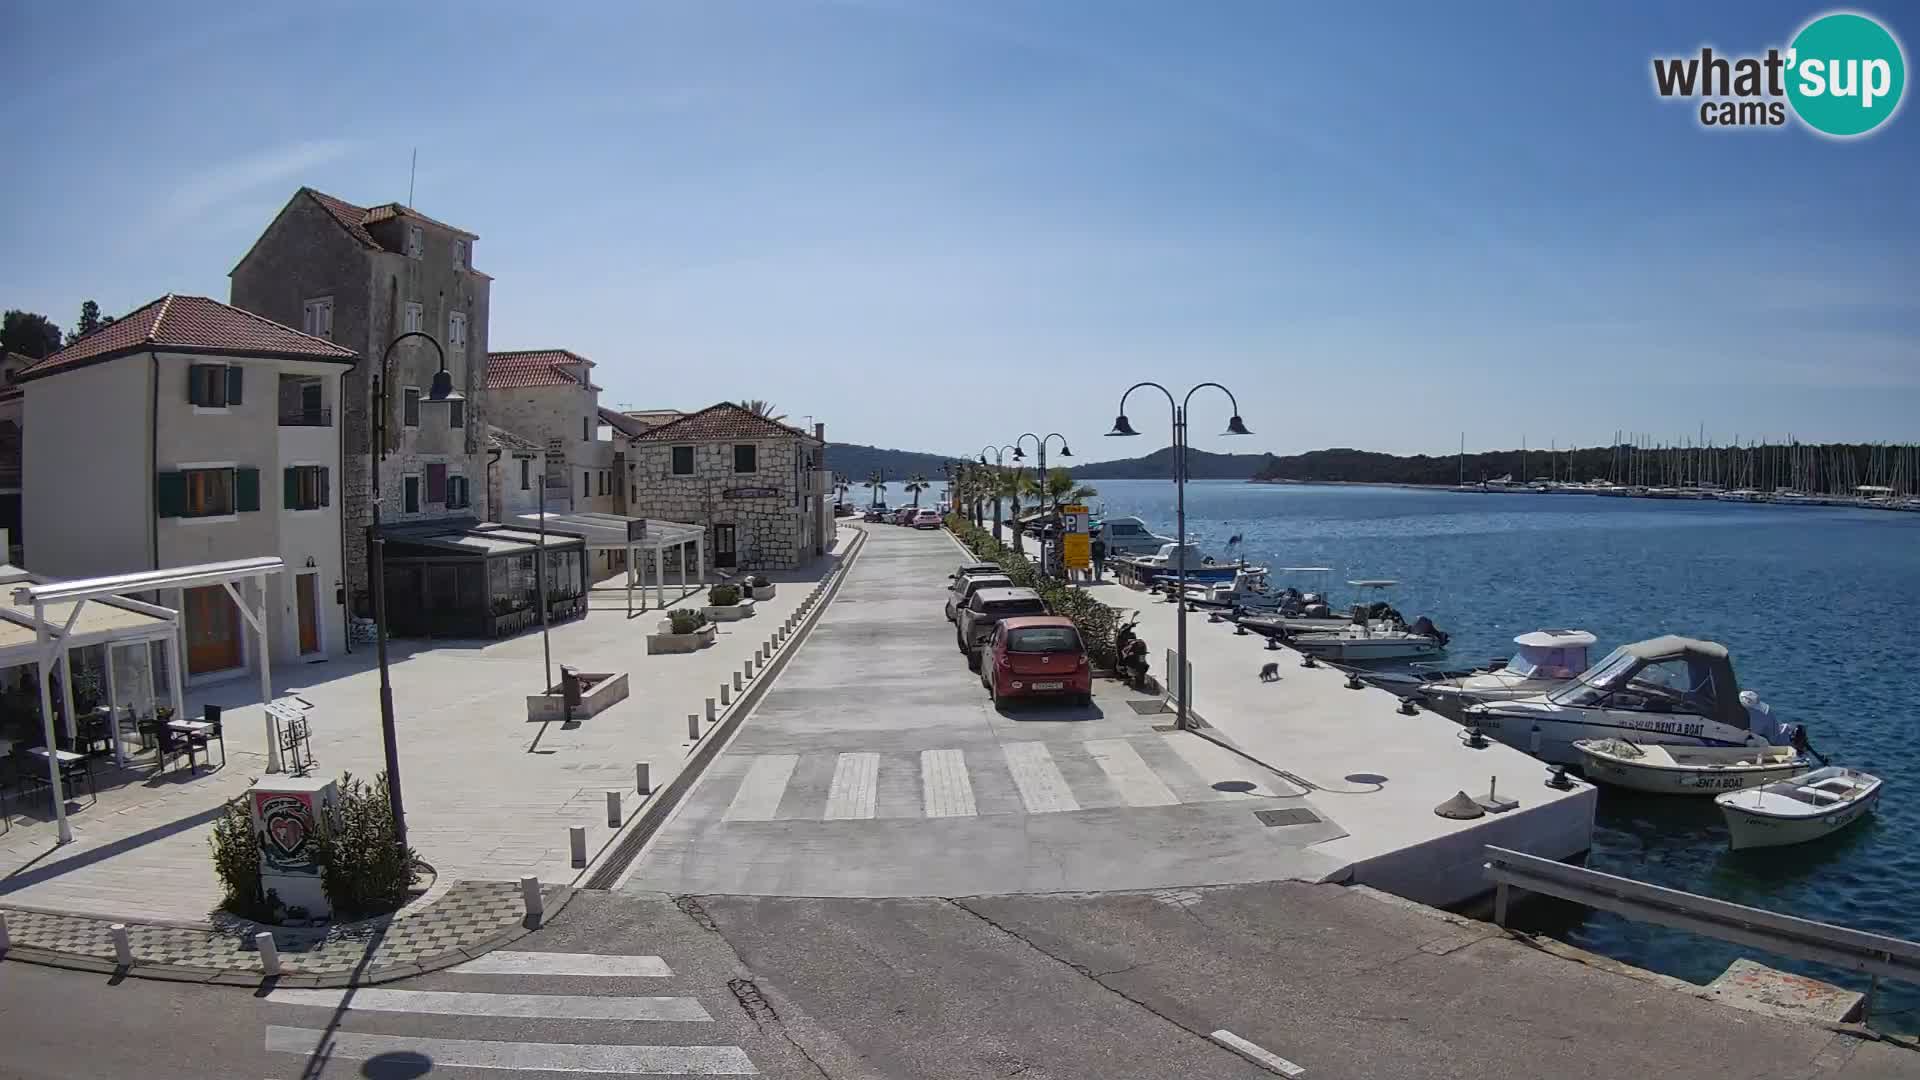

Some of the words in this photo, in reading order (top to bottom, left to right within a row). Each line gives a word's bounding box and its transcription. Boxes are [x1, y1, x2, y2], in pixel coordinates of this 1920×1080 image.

[1066, 515, 1076, 531] P
[1655, 721, 1676, 733] RENT
[1677, 723, 1682, 733] A
[1684, 723, 1704, 736] BOAT
[1715, 779, 1721, 788] A
[1722, 777, 1744, 788] BOAT
